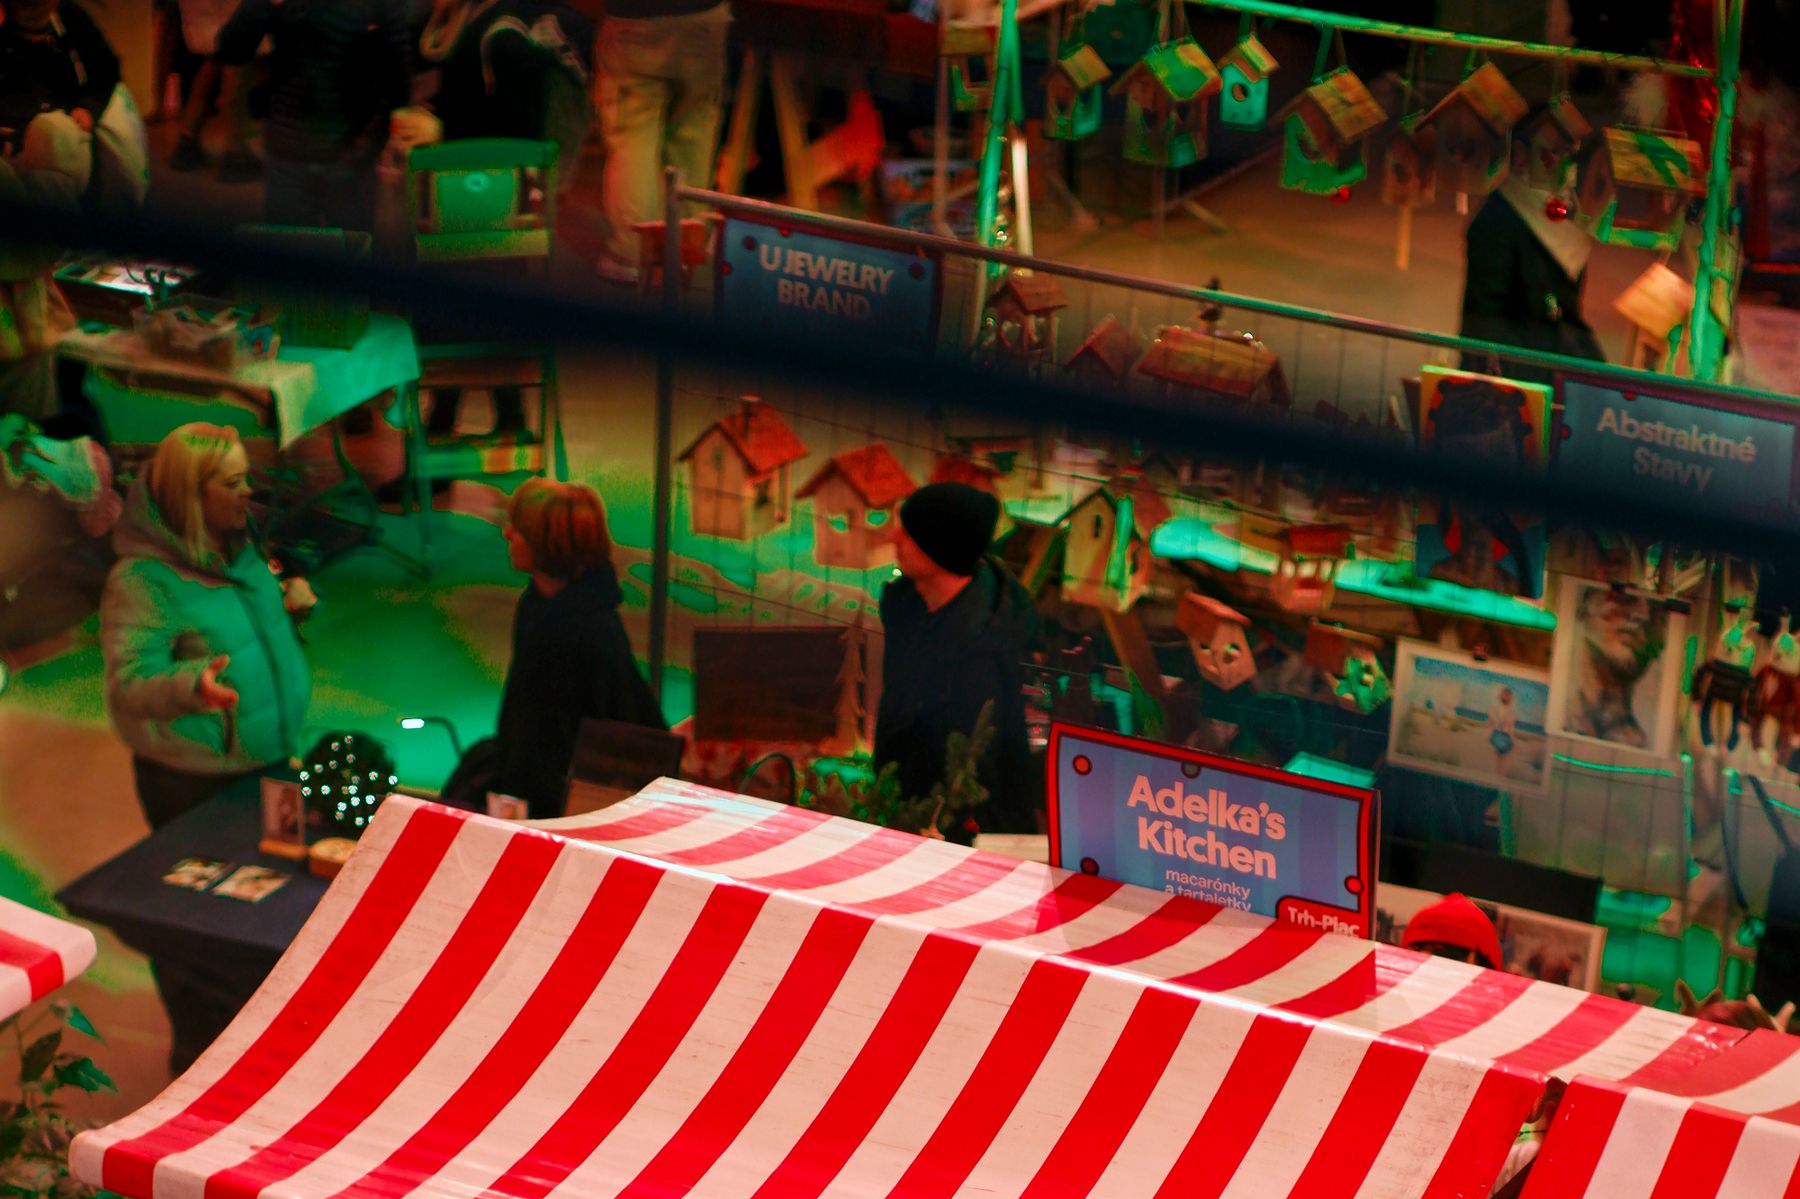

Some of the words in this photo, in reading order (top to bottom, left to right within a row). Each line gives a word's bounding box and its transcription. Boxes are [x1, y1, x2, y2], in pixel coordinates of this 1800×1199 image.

[777, 278, 872, 320] BRAND
[1596, 407, 1758, 464] Abstraktné
[1633, 446, 1715, 493] Stavy
[1126, 774, 1287, 840] Adelka's
[1137, 815, 1278, 880] Kitchen
[1165, 869, 1251, 901] macarónky
[1165, 884, 1175, 895] a
